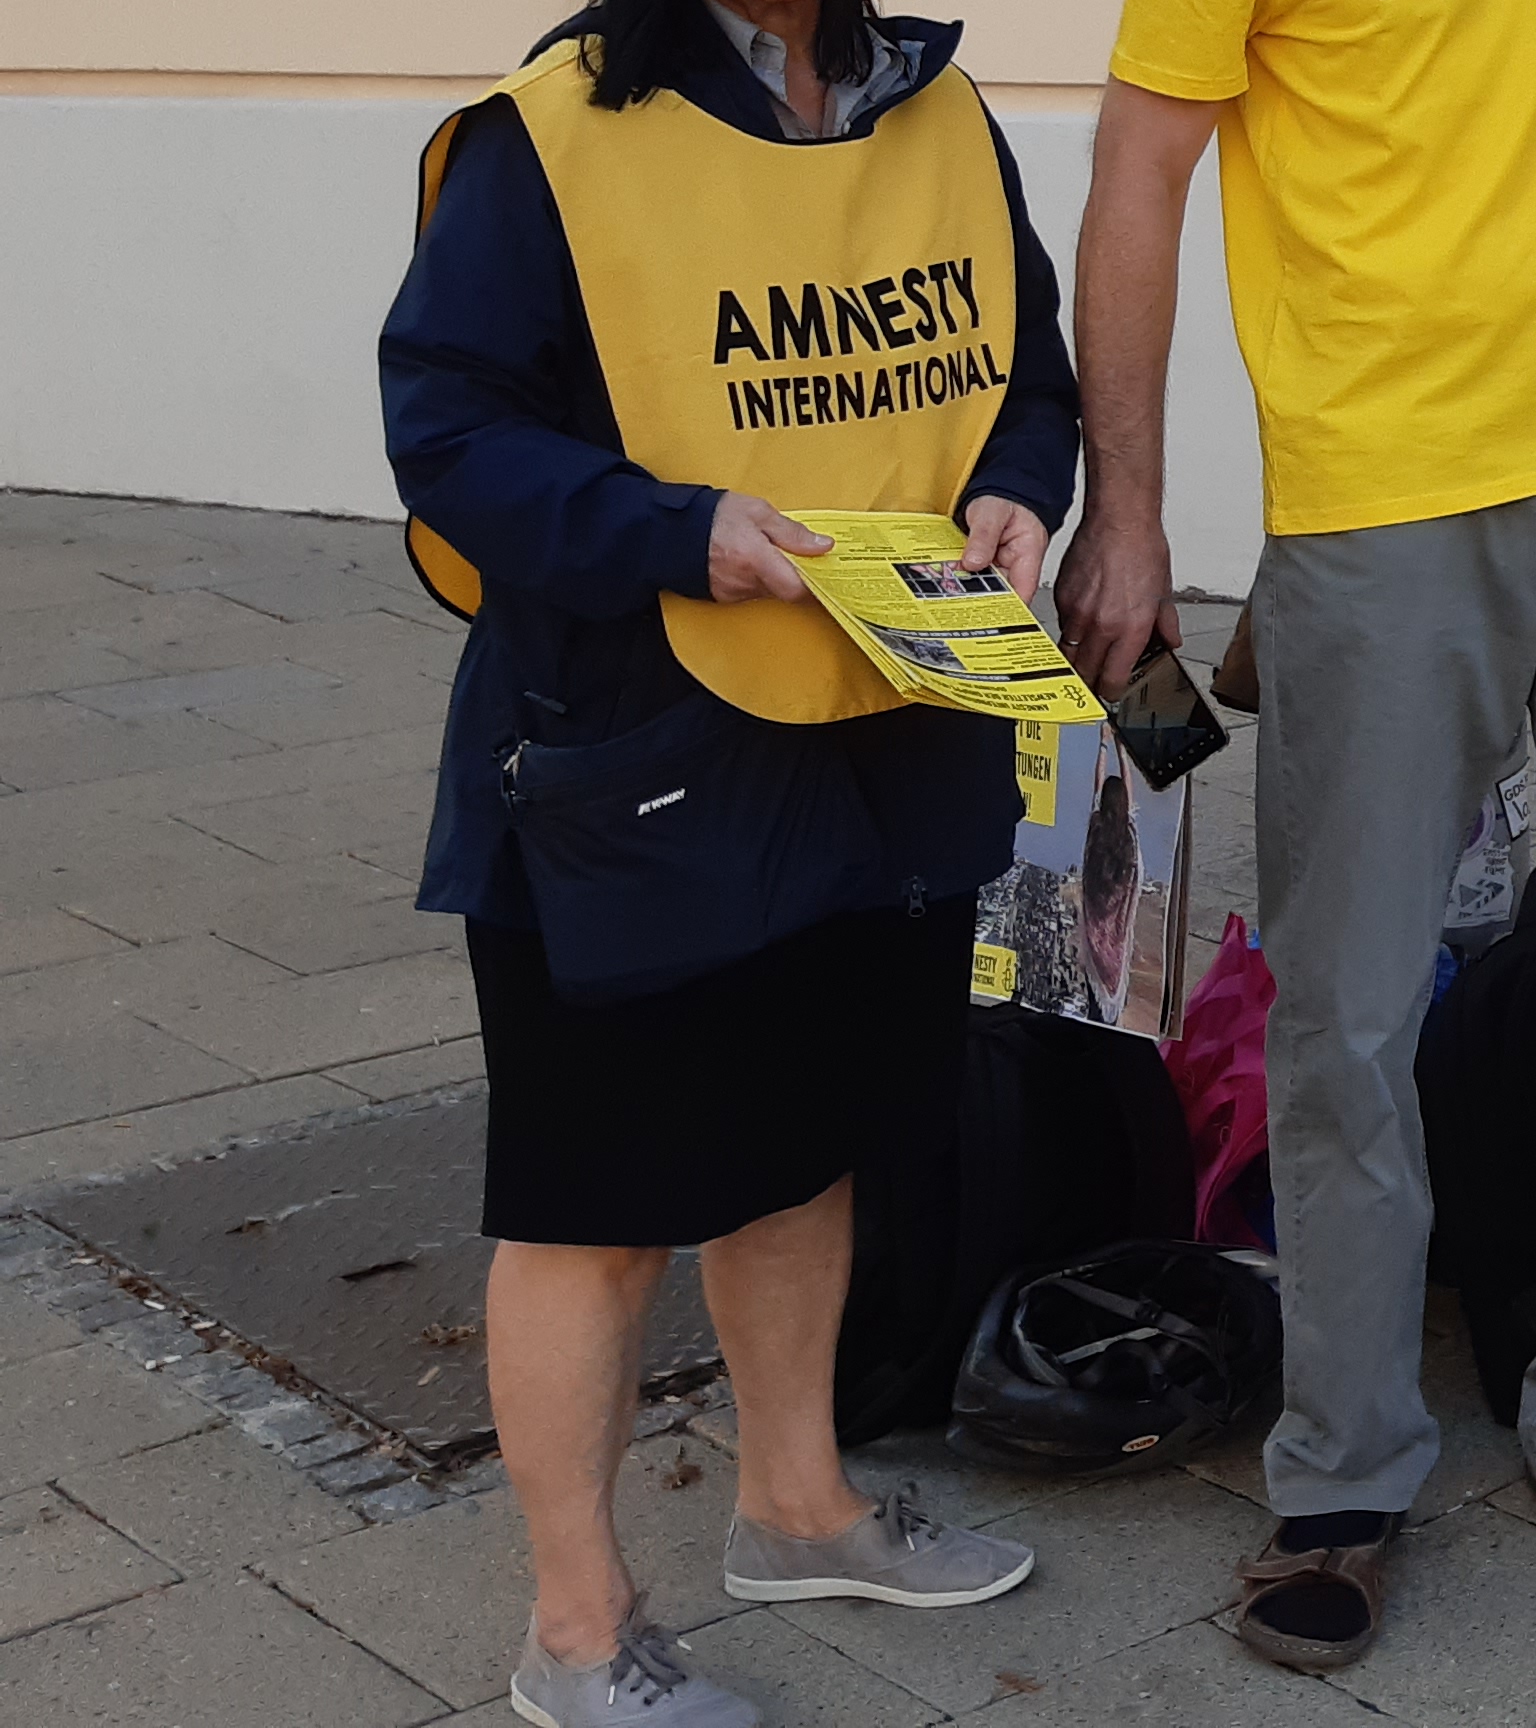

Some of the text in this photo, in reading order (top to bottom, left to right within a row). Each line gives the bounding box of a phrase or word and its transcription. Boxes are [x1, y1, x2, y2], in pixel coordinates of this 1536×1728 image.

[713, 257, 980, 365] AMNESTY
[726, 343, 1008, 431] INTERNATIONAL
[1016, 751, 1052, 782] TUNGEN
